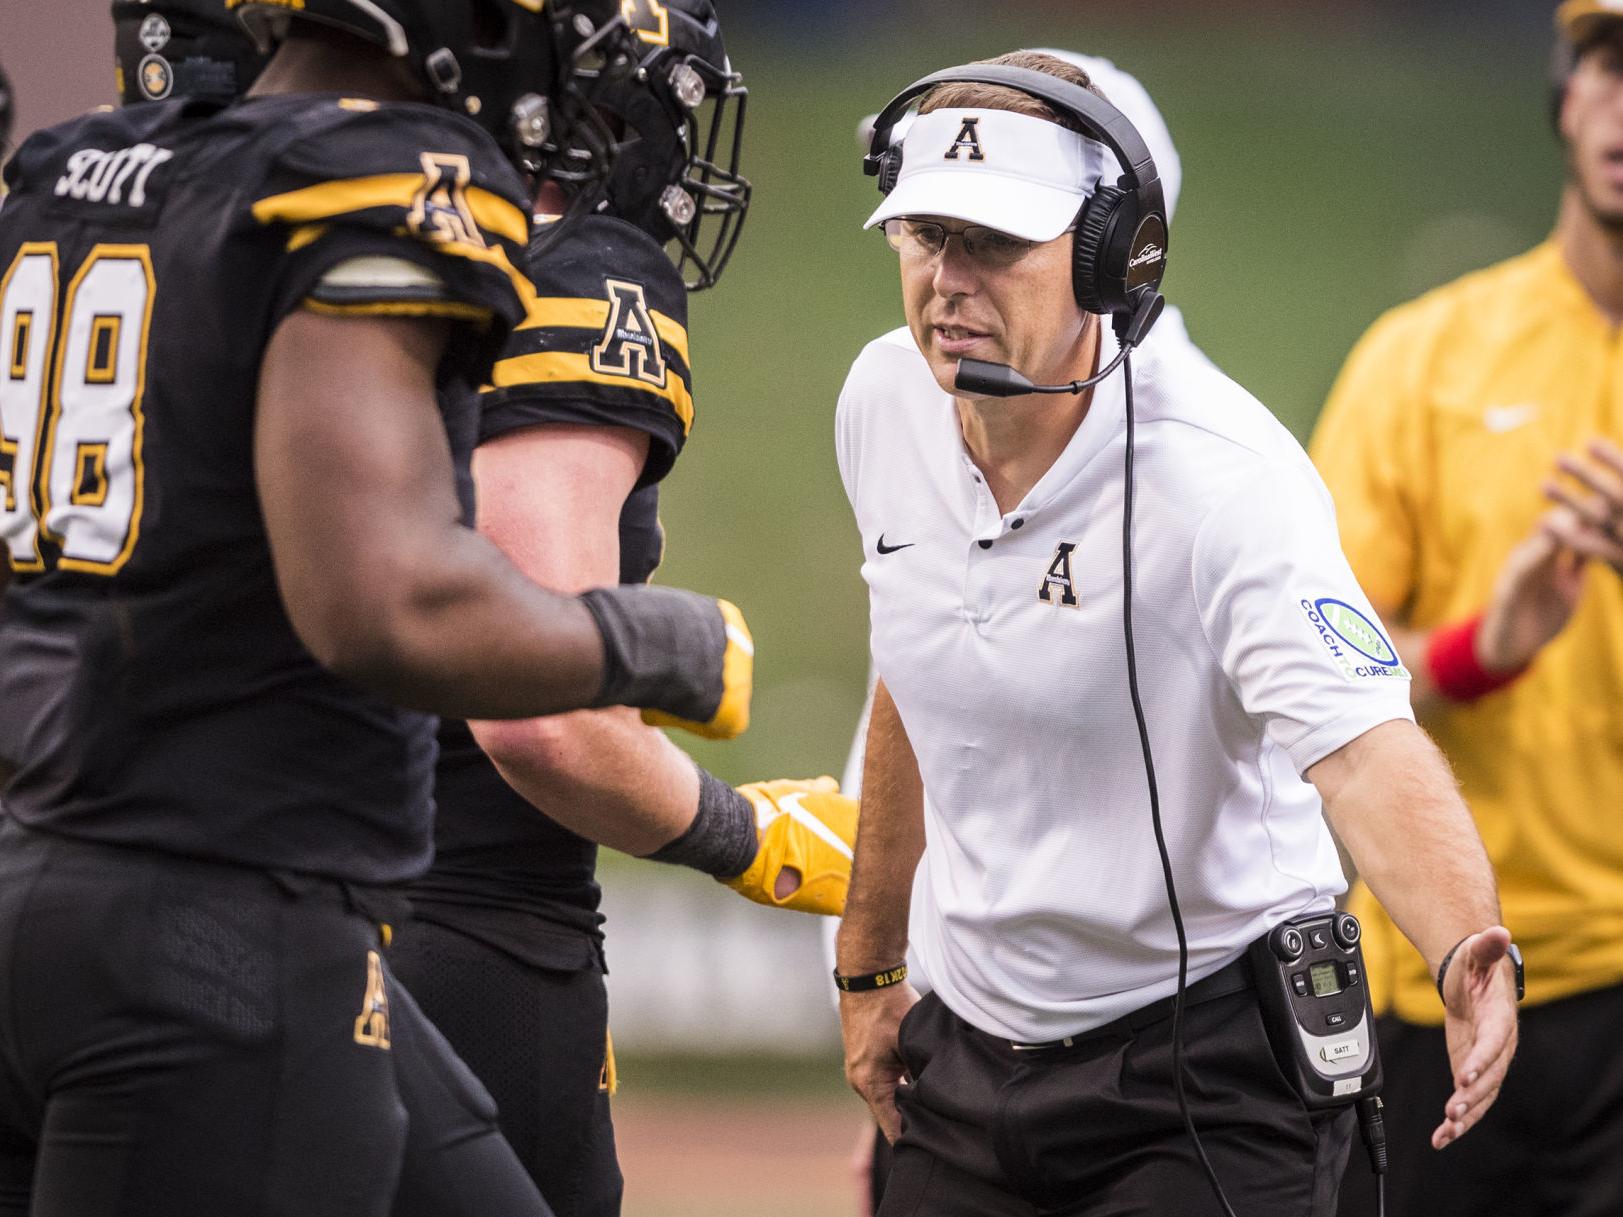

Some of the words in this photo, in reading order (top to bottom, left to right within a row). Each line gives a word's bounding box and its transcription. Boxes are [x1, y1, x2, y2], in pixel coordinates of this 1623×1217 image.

[944, 115, 985, 162] A
[54, 143, 174, 208] SCOTT
[593, 278, 666, 387] A
[0, 241, 157, 576] 98
[1037, 540, 1081, 608] A
[1301, 599, 1344, 658] COACH
[1331, 1015, 1342, 1023] CALL
[1334, 1045, 1351, 1055] SATT
